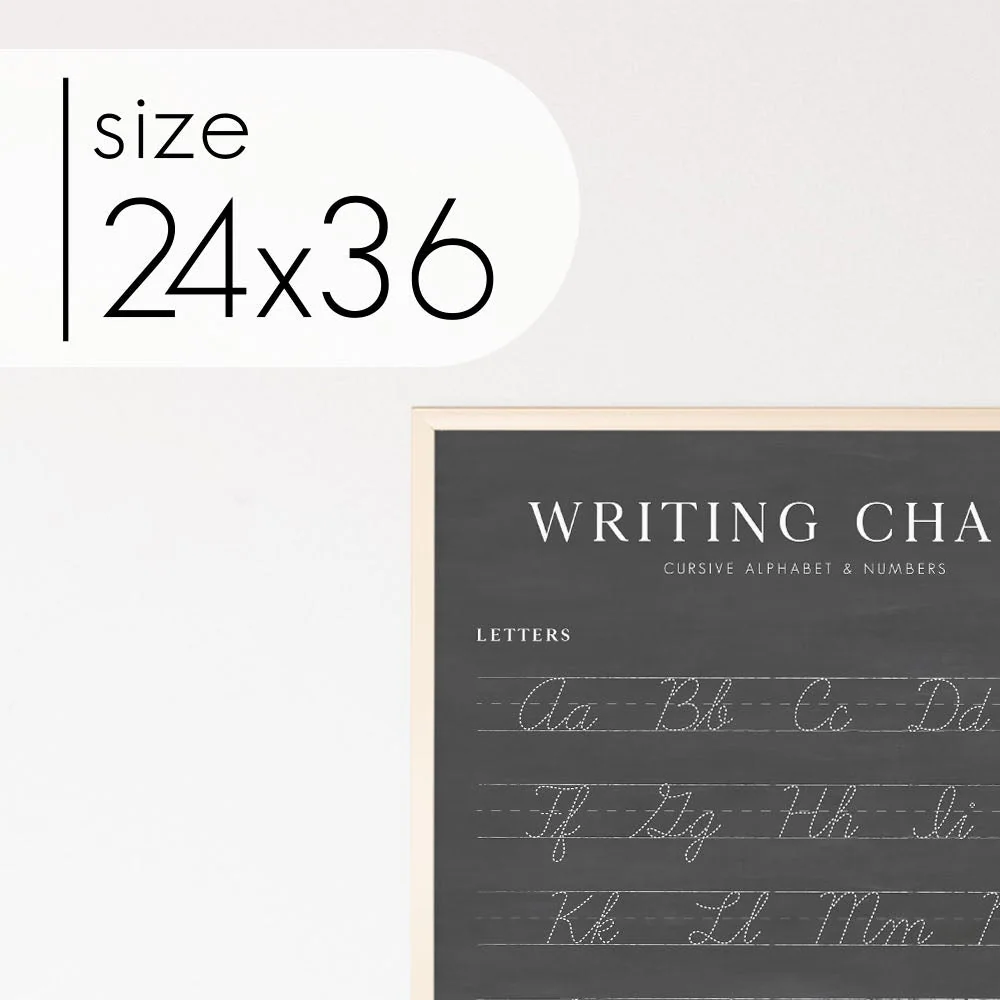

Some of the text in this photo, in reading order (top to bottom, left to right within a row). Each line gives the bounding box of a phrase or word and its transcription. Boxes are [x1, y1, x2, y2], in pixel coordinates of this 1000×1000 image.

[528, 501, 817, 543] WRITING
[663, 561, 946, 575] CURSIVE ALPHABET & NUMBERS
[476, 627, 571, 642] LETTERS
[518, 677, 598, 731] Aa
[655, 677, 734, 731] Bb
[793, 677, 853, 731] Cc
[907, 677, 992, 731] Dd
[525, 784, 590, 863] Ff
[630, 783, 722, 863] Gg
[779, 784, 859, 838] Hh
[912, 785, 977, 839] Ii
[546, 891, 621, 945] Kk
[688, 891, 770, 945] Ll
[815, 891, 934, 945] Mm
